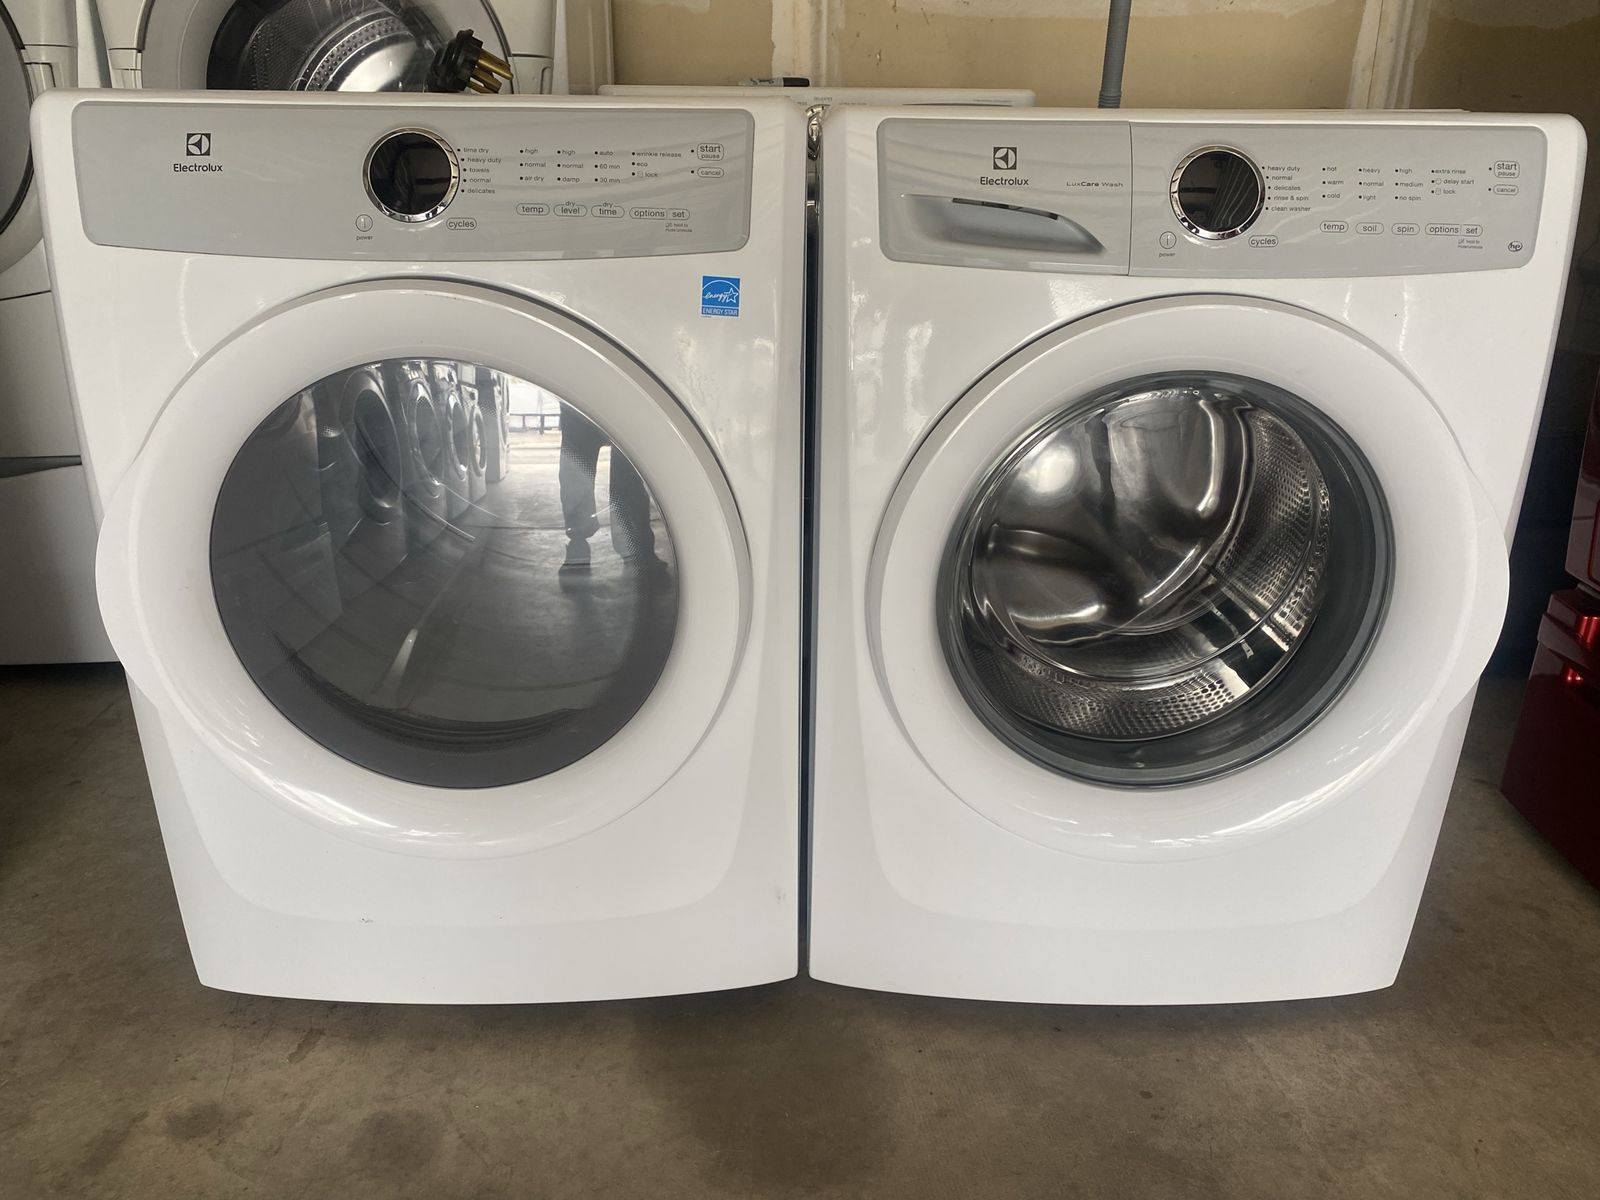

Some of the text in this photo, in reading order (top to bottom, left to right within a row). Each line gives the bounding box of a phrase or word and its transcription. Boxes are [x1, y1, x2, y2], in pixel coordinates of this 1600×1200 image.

[699, 145, 721, 153] start
[173, 163, 223, 173] Electrolux
[1496, 162, 1518, 171] start
[979, 176, 1030, 187] Electrolux
[1443, 178, 1460, 186] delay
[1495, 186, 1517, 194] cancel
[1296, 194, 1309, 202] spin
[521, 205, 545, 215] temp
[560, 206, 580, 215] level
[598, 207, 618, 216] time
[633, 208, 666, 219] options
[672, 210, 686, 219] set
[448, 219, 475, 229] cycles
[1323, 222, 1346, 232] temp
[1362, 224, 1377, 233] soil
[1396, 225, 1415, 234] spin
[1429, 226, 1460, 236] options
[1465, 227, 1479, 235] set
[1250, 237, 1277, 247] cycles
